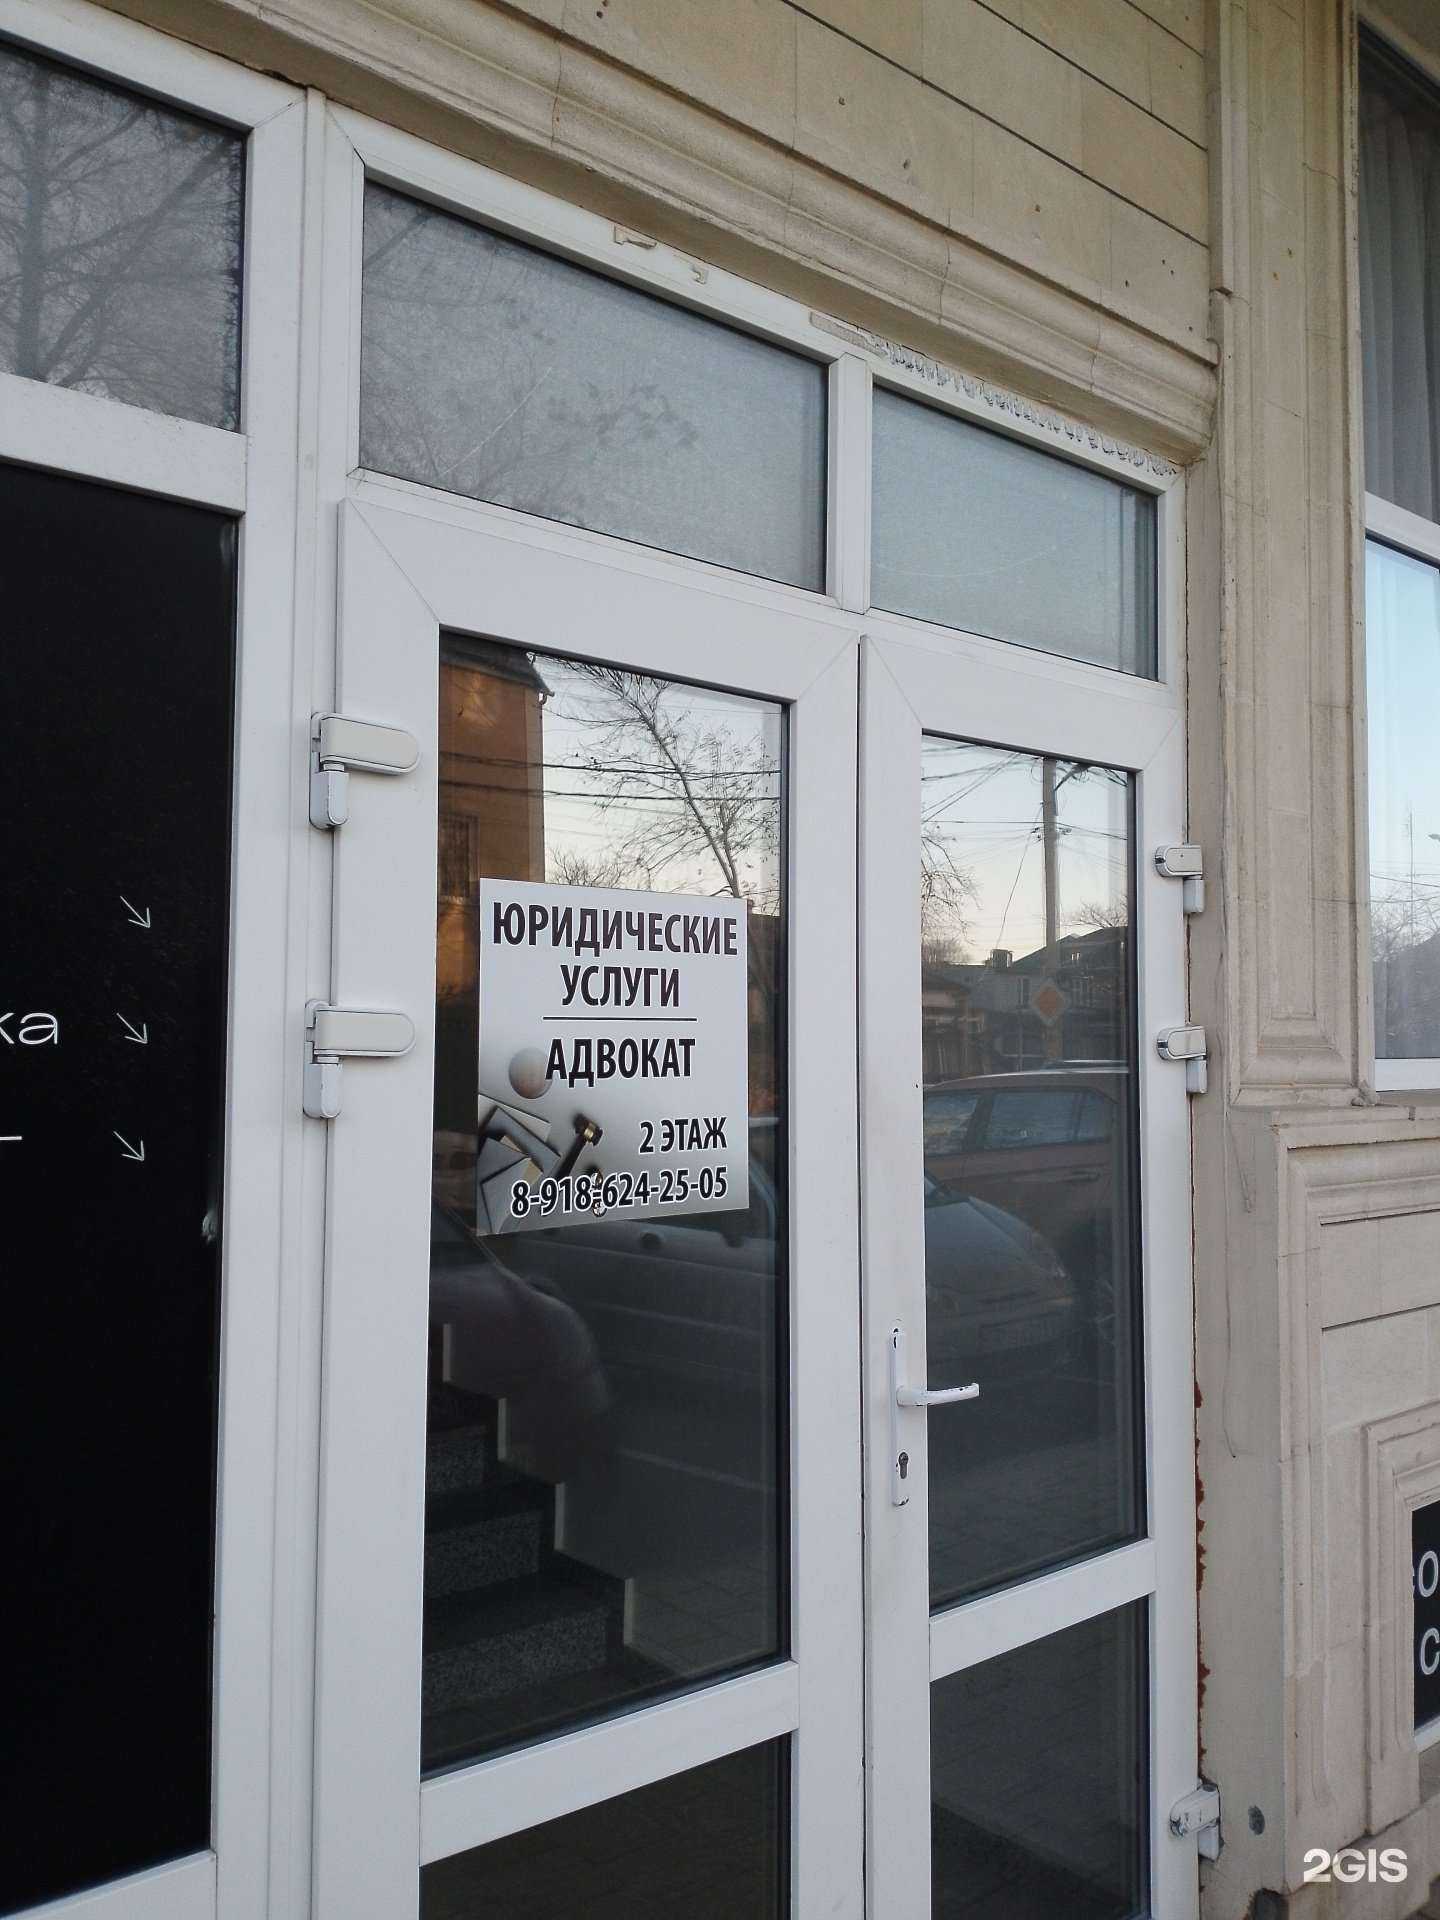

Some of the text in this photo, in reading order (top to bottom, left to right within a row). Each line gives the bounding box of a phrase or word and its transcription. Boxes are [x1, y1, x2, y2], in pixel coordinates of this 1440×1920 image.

[493, 902, 738, 957] ЮРИДИЧЕСКИЕ
[560, 964, 680, 1007] УСЛУГИ
[545, 1038, 696, 1088] АДВОКАТ
[638, 1116, 728, 1154] 2 ЭТАЖ
[510, 1166, 728, 1217] 8-918-624-25-05
